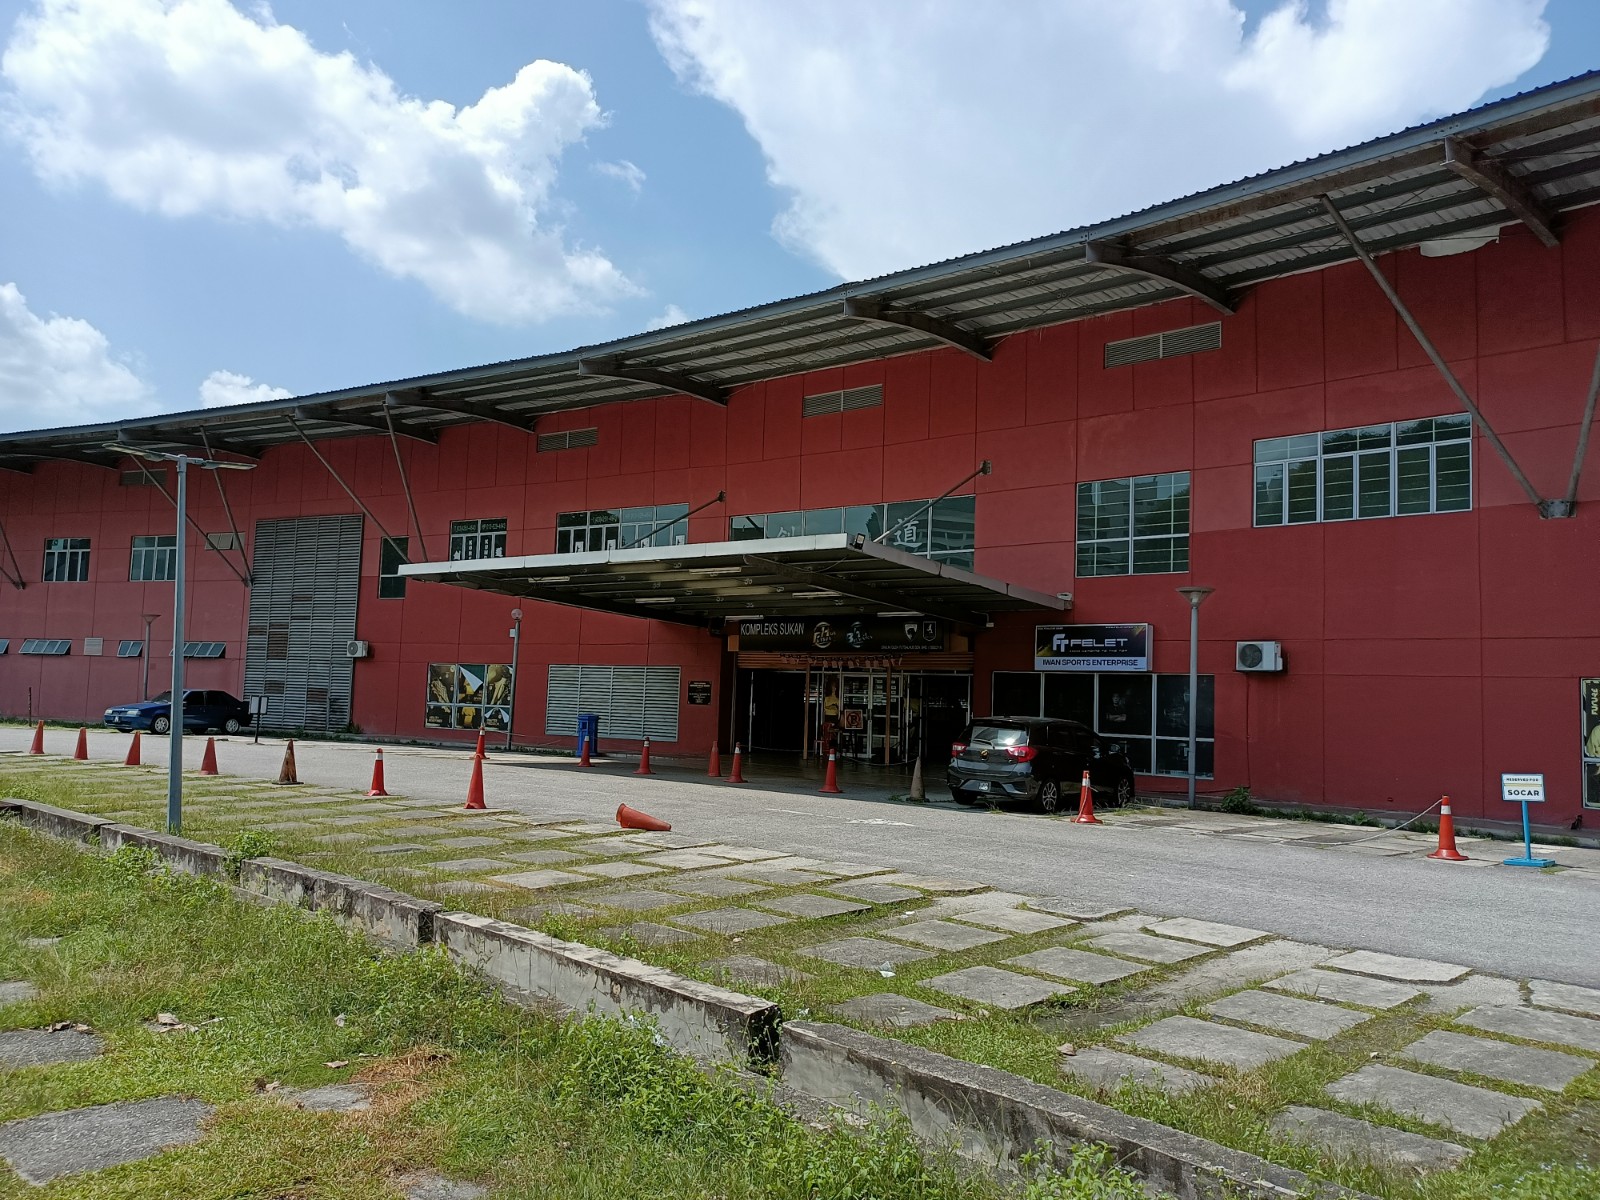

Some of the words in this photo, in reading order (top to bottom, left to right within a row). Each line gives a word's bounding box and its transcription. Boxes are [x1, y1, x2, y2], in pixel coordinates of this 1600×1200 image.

[893, 516, 923, 548] 道
[740, 622, 779, 636] KOMPLEKS
[779, 622, 805, 635] SUKAN
[1070, 638, 1129, 647] FELET
